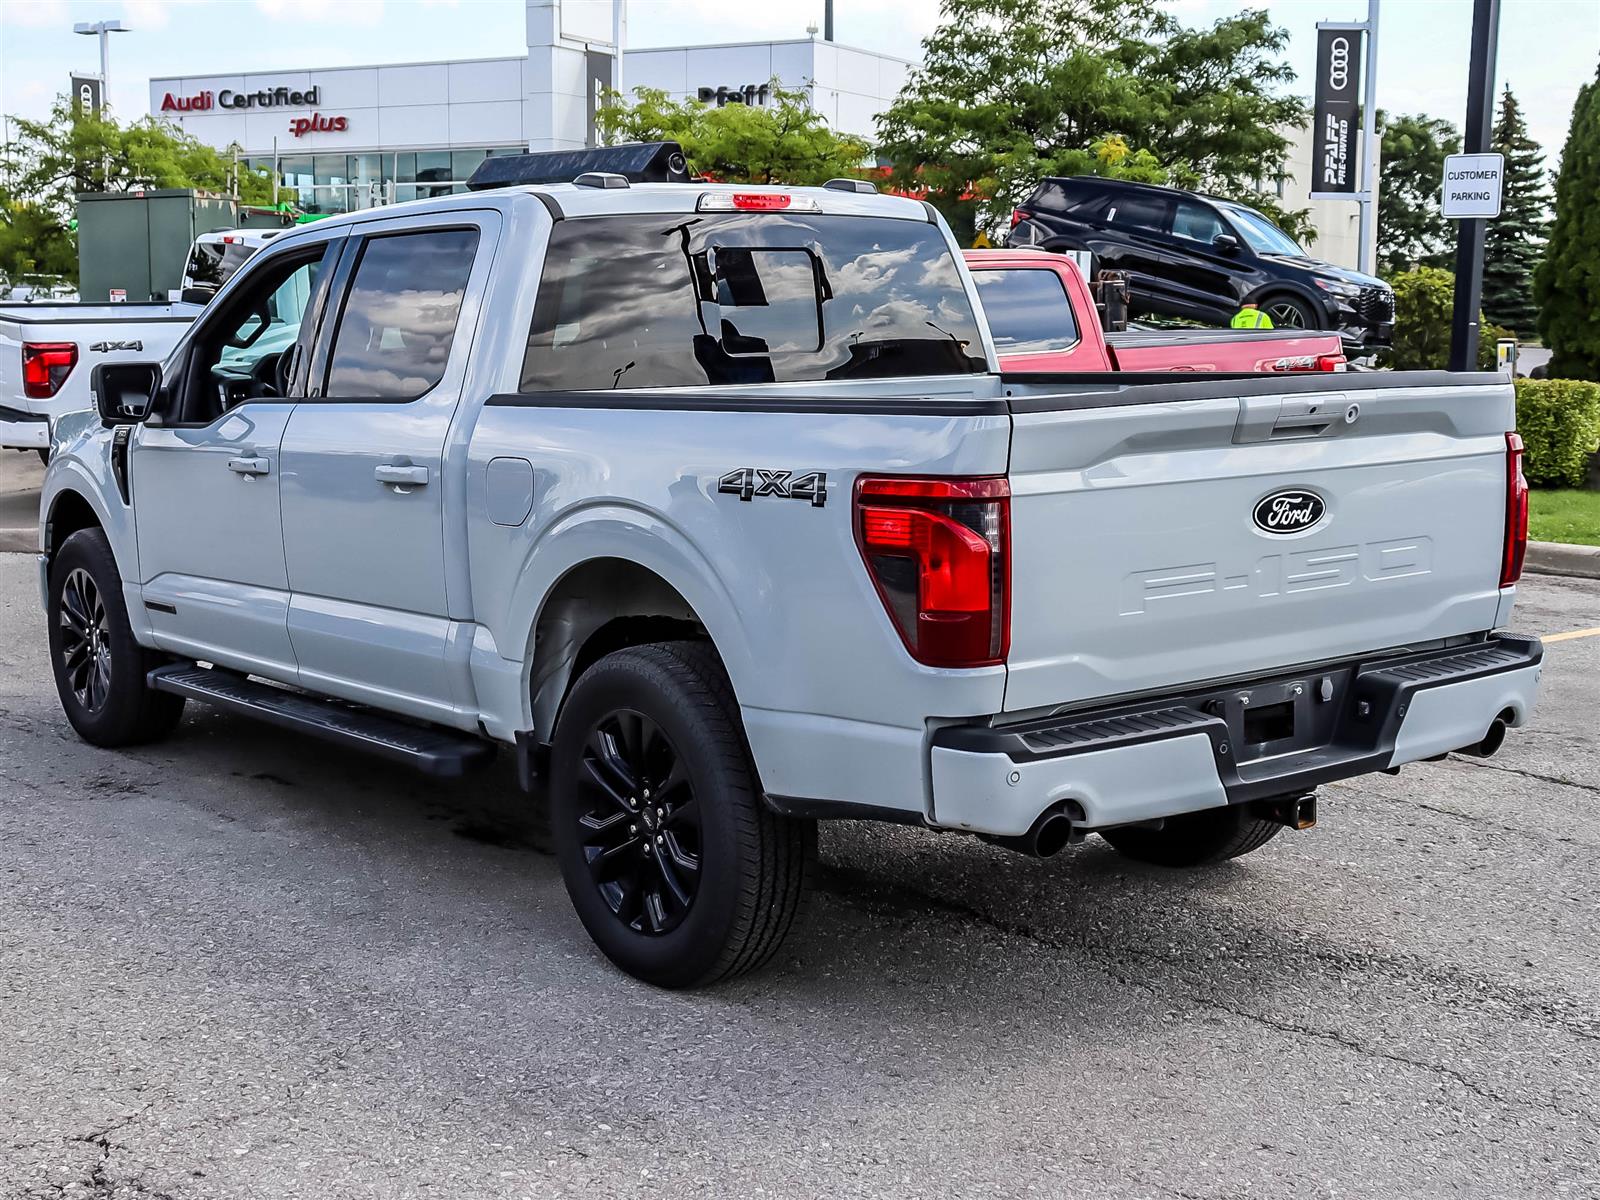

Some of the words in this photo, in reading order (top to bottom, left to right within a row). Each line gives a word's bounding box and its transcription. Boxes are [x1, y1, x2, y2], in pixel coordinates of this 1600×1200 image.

[161, 91, 213, 111] Audi
[218, 85, 320, 109] Certified
[1323, 113, 1341, 185] PFAFF
[1337, 119, 1348, 185] PRE-OWNED
[1447, 170, 1498, 181] CUSTOMER
[1451, 191, 1491, 201] PARKING
[1267, 497, 1314, 527] Ford
[1118, 534, 1433, 616] F-150
